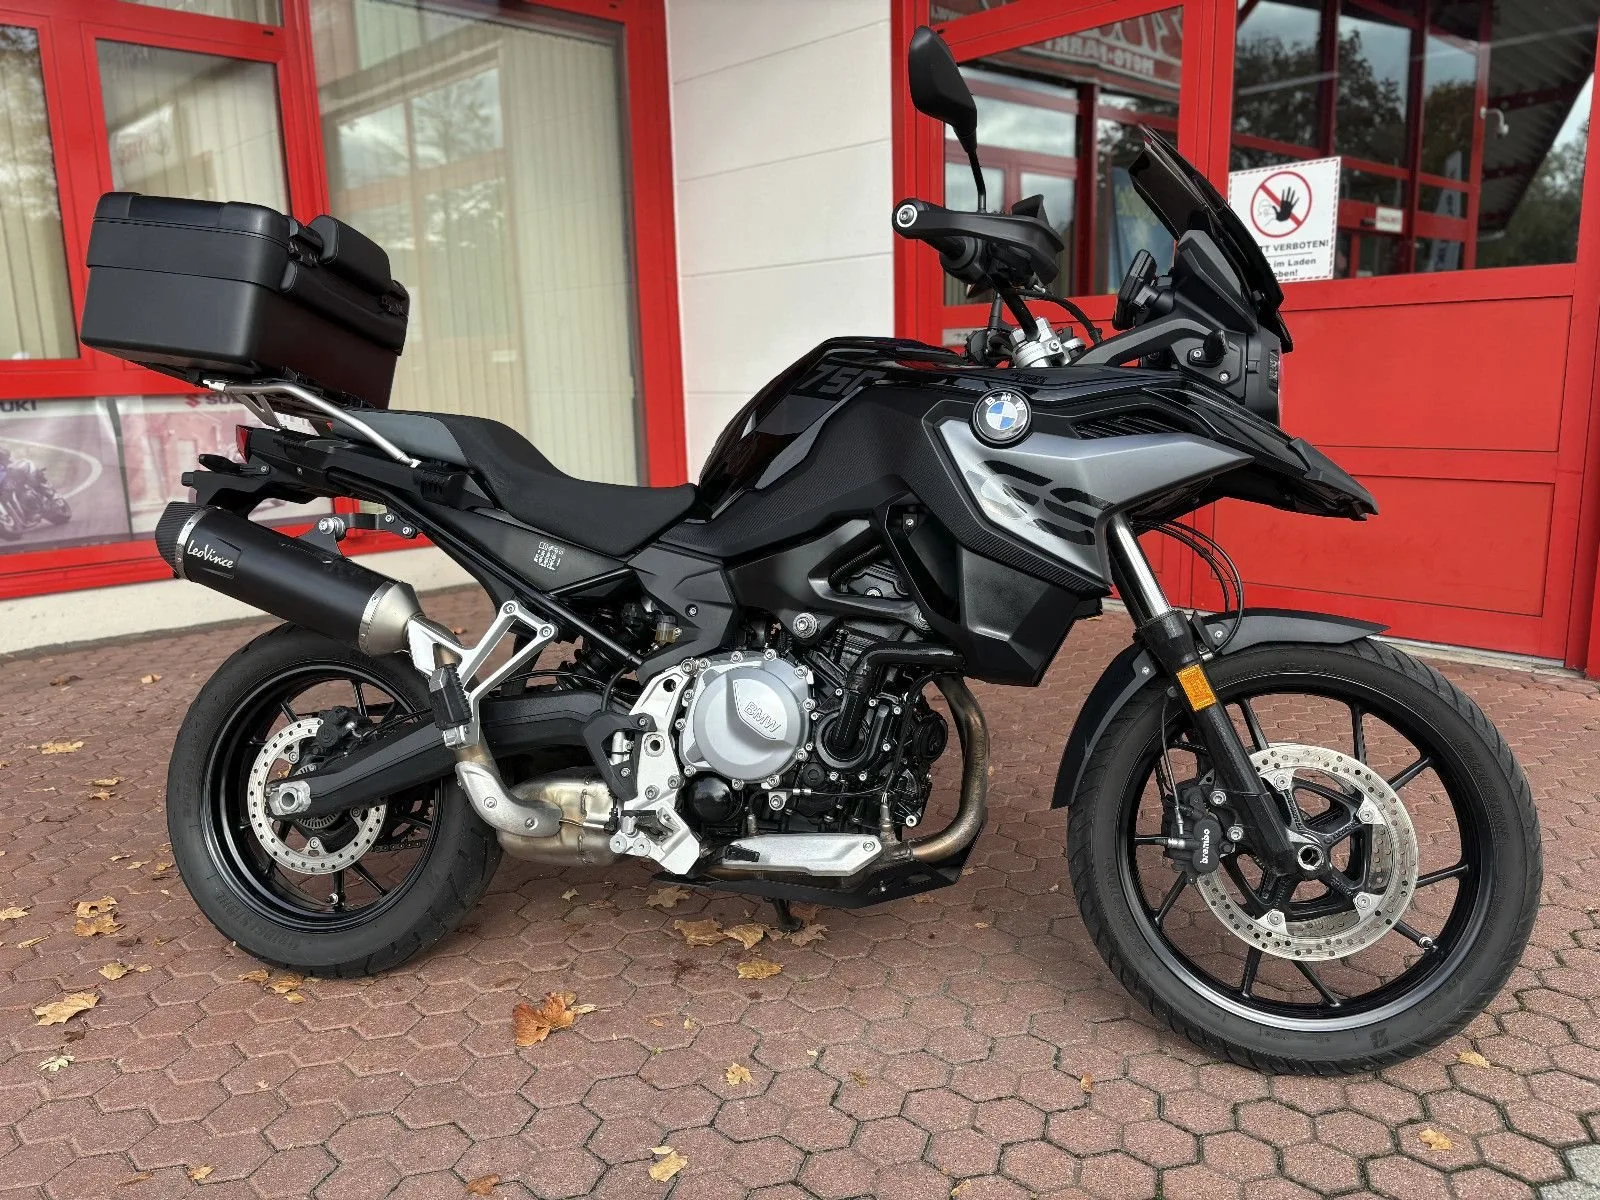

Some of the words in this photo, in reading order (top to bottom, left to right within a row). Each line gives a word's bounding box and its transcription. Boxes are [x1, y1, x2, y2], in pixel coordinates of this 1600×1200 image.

[1273, 239, 1329, 251] VERBOTEN!
[1274, 260, 1285, 268] im
[1288, 258, 1317, 267] Laden
[985, 392, 1026, 411] BMW
[187, 539, 234, 568] LeoVince
[744, 700, 782, 733] BMW
[1200, 828, 1211, 865] brembo
